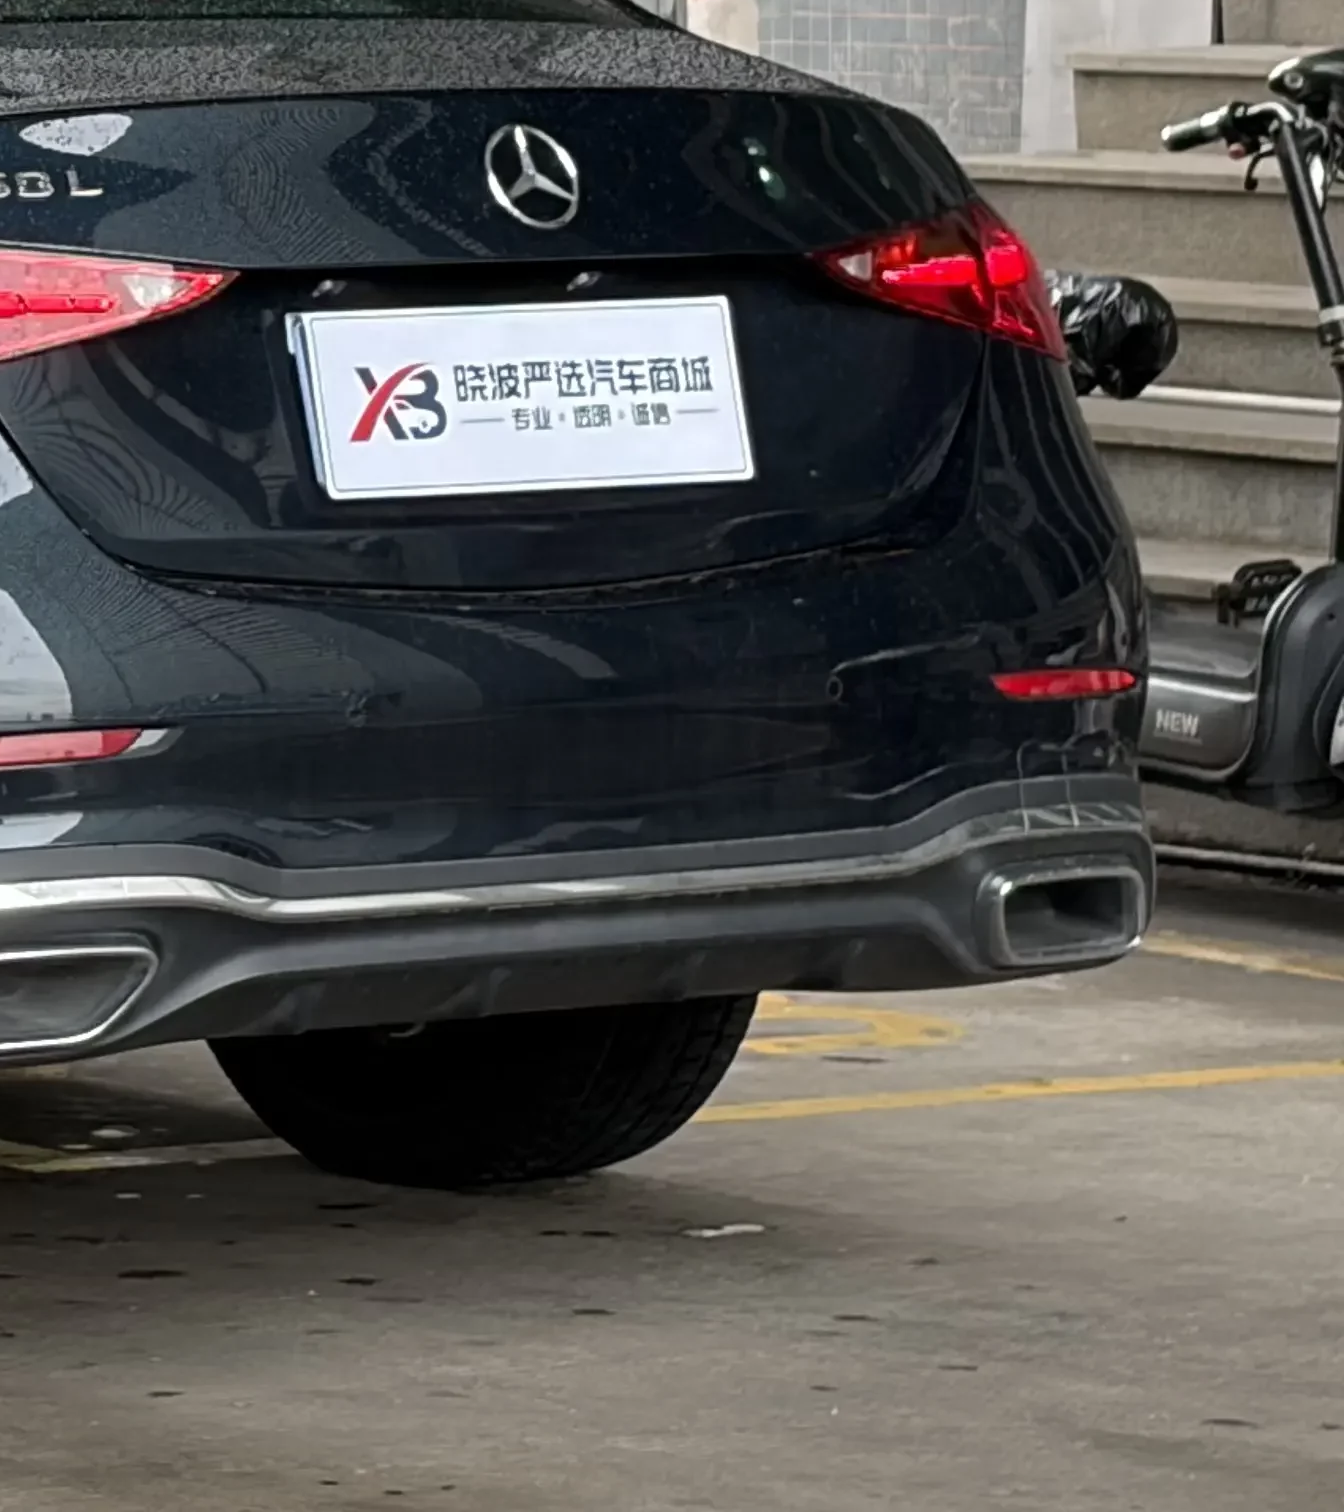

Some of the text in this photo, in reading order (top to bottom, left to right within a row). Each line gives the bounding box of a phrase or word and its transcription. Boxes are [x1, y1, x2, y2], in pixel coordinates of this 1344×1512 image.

[65, 164, 104, 197] L
[452, 355, 714, 402] 晓波严选汽车商城
[1155, 708, 1200, 738] NEW
